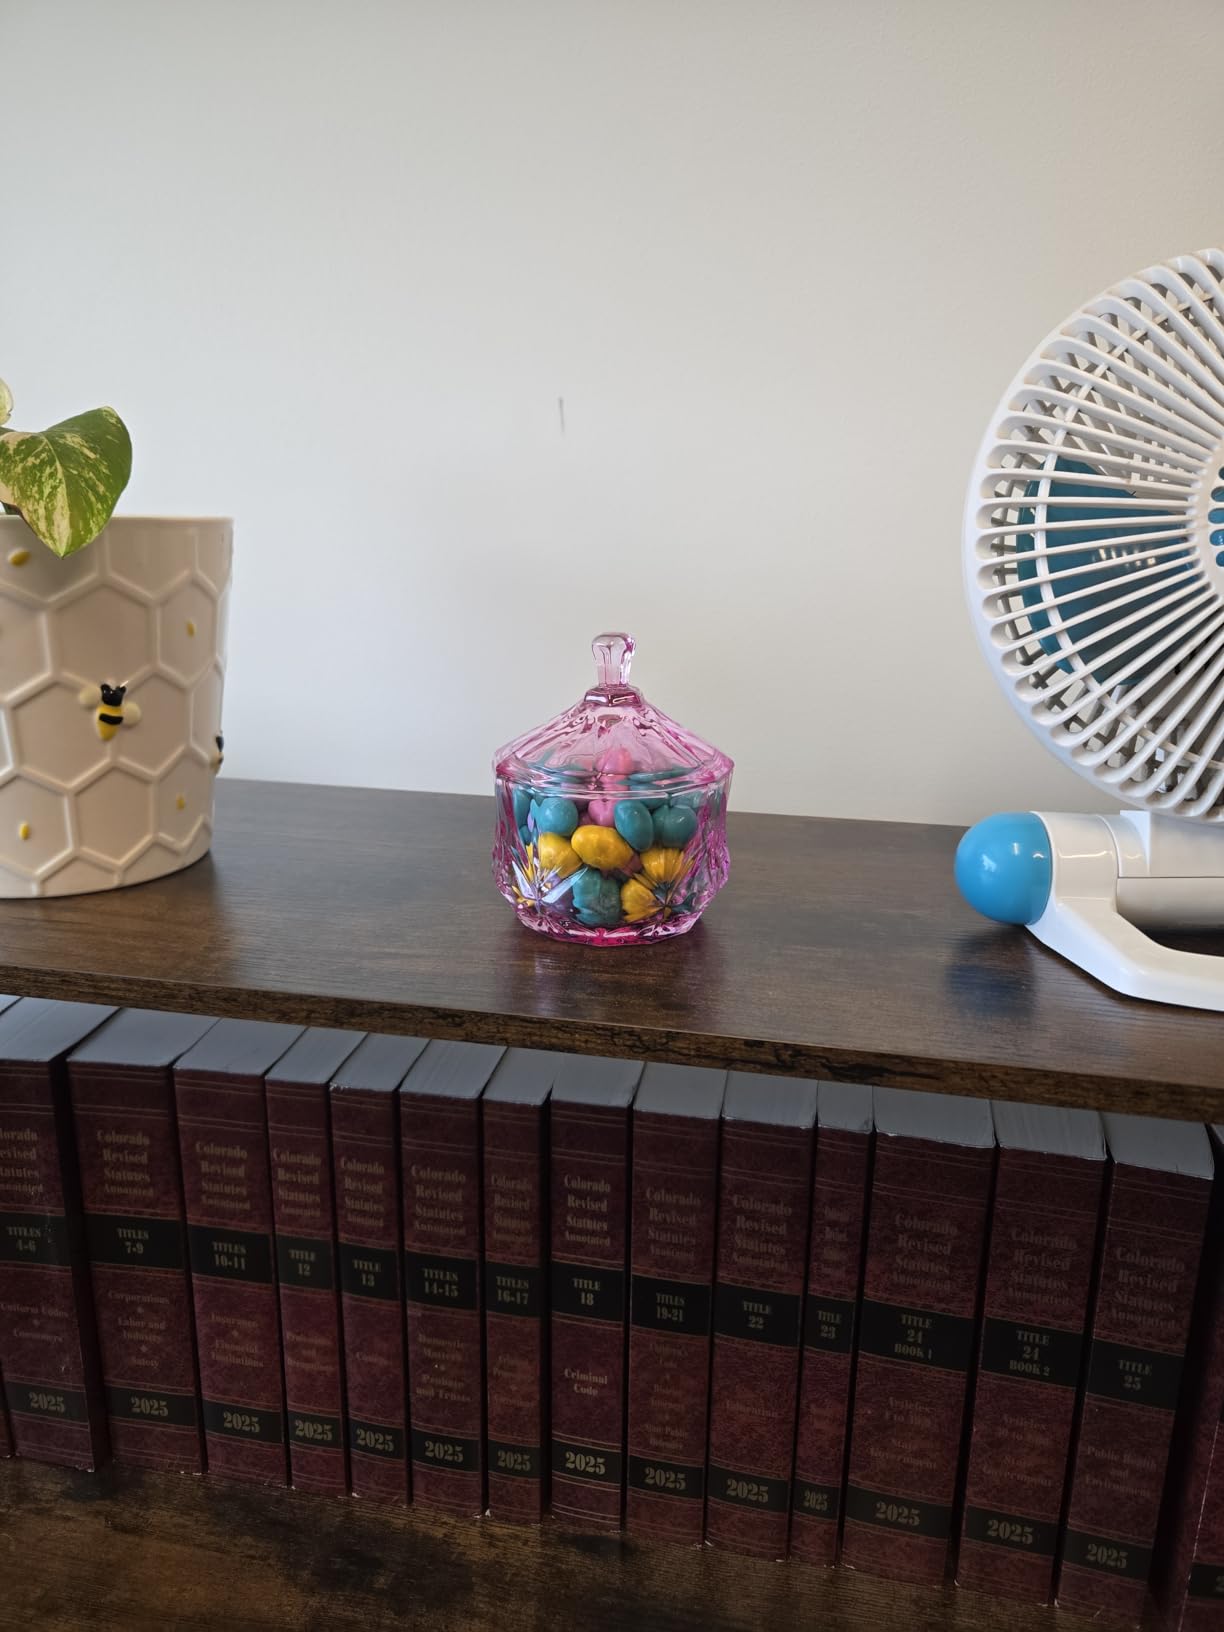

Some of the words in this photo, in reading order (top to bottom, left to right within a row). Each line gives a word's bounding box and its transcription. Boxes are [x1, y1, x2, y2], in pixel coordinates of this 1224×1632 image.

[0, 1128, 38, 1141] lorado
[97, 1130, 150, 1146] Colorado
[0, 1146, 36, 1160] evised
[103, 1149, 149, 1164] Revised
[195, 1140, 248, 1160] Colorado
[273, 1148, 321, 1166] Colorado
[201, 1160, 245, 1177] Revised
[340, 1156, 384, 1175] Colorado
[411, 1163, 466, 1184] Colorado
[104, 1168, 151, 1183] Statutes
[563, 1174, 611, 1193] Colorado
[344, 1176, 384, 1194] Revised
[415, 1184, 463, 1202] Revised
[567, 1193, 608, 1212] Revised
[646, 1186, 702, 1207] Colorado
[415, 1204, 464, 1222] Statutes
[733, 1194, 792, 1217] Colorado
[566, 1213, 608, 1231] Statutes
[649, 1207, 697, 1225] Revised
[895, 1212, 958, 1236] Colorado
[6, 1226, 41, 1237] TITLES
[736, 1215, 787, 1235] Revised
[117, 1228, 149, 1240] TITLES
[565, 1230, 611, 1247] Annotated
[648, 1226, 697, 1246] Statutes
[1012, 1227, 1077, 1250] Colorado
[16, 1240, 37, 1253] 4-6
[125, 1242, 144, 1254] 7-9
[212, 1241, 247, 1254] TITLES
[734, 1234, 786, 1256] Statutes
[898, 1234, 951, 1256] Revised
[214, 1254, 246, 1271] 10-11
[288, 1249, 316, 1261] TITLE
[1014, 1248, 1071, 1271] Revised
[1116, 1246, 1185, 1272] Colorado
[298, 1263, 311, 1276] 12
[352, 1259, 382, 1272] TITLE
[361, 1274, 375, 1287] 13
[422, 1268, 459, 1281] TITLES
[496, 1276, 529, 1289] TITLES
[1118, 1268, 1178, 1292] Revised
[424, 1281, 459, 1297] 14-15
[572, 1277, 601, 1291] TITLE
[497, 1290, 529, 1305] 16-17
[580, 1292, 595, 1306] 18
[656, 1293, 685, 1306] TITLES
[656, 1306, 684, 1322] 19-21
[743, 1301, 770, 1314] TITLE
[748, 1316, 764, 1329] 22
[817, 1310, 841, 1324] TITLE
[902, 1314, 932, 1329] TITLE
[820, 1325, 836, 1339] 23
[907, 1329, 923, 1344] 24
[1016, 1330, 1050, 1345] TITLE
[894, 1344, 924, 1359] BOOK
[1023, 1346, 1039, 1360] 24
[563, 1367, 609, 1385] Criminal
[1009, 1360, 1040, 1374] BOOK
[1043, 1366, 1050, 1377] 2
[1118, 1359, 1152, 1376] TITLE
[1123, 1375, 1142, 1391] 25
[29, 1392, 66, 1413] 2025
[131, 1396, 169, 1416] 2025
[223, 1411, 261, 1433] 2025
[295, 1419, 333, 1441] 2025
[356, 1428, 394, 1451] 2025
[425, 1440, 464, 1463] 2025
[497, 1450, 531, 1471] 2025
[564, 1450, 606, 1475] 2025
[645, 1467, 686, 1490] 2025
[726, 1479, 769, 1504] 2025
[803, 1490, 828, 1511] 2025
[875, 1501, 921, 1526] 2025
[987, 1519, 1034, 1545] 2025
[1085, 1543, 1128, 1568] 2025
